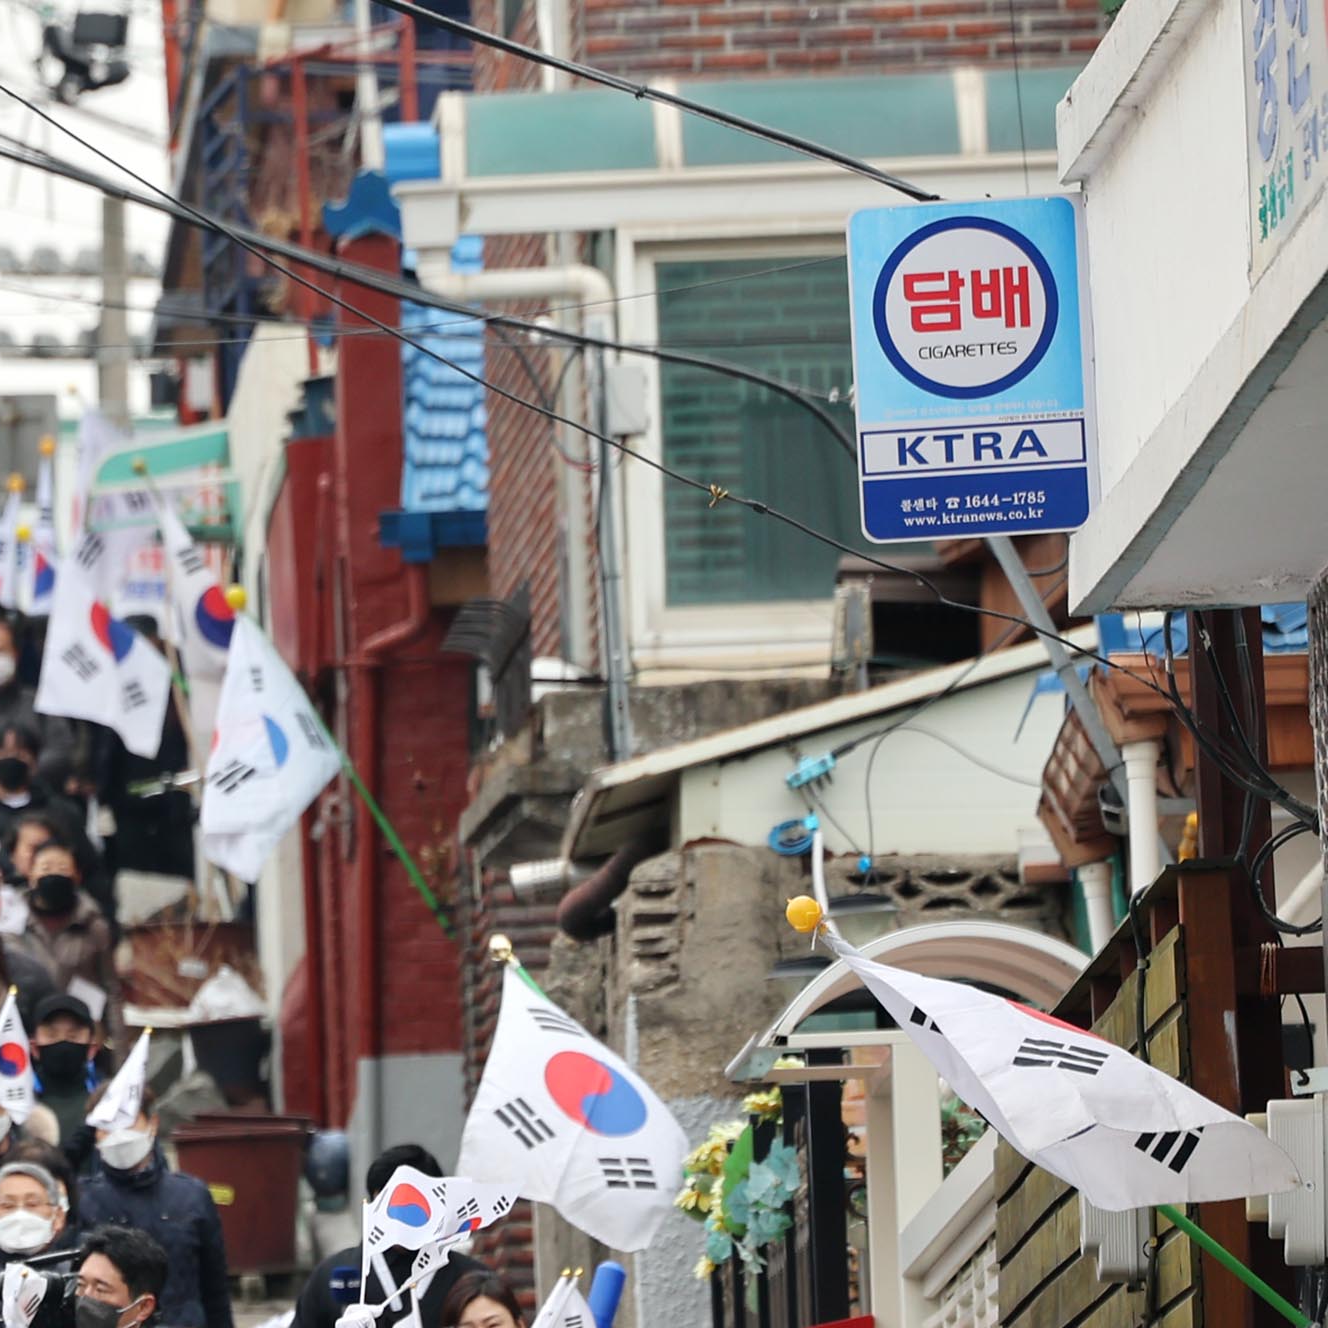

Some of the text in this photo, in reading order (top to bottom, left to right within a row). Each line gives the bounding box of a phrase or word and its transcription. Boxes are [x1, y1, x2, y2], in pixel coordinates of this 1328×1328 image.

[903, 266, 1031, 333] 담배
[918, 341, 1018, 360] CIGARETTES
[897, 428, 1049, 467] KTRA
[964, 491, 1046, 509] 1644-1785
[903, 507, 1044, 527] www.ktranews.co.kr
